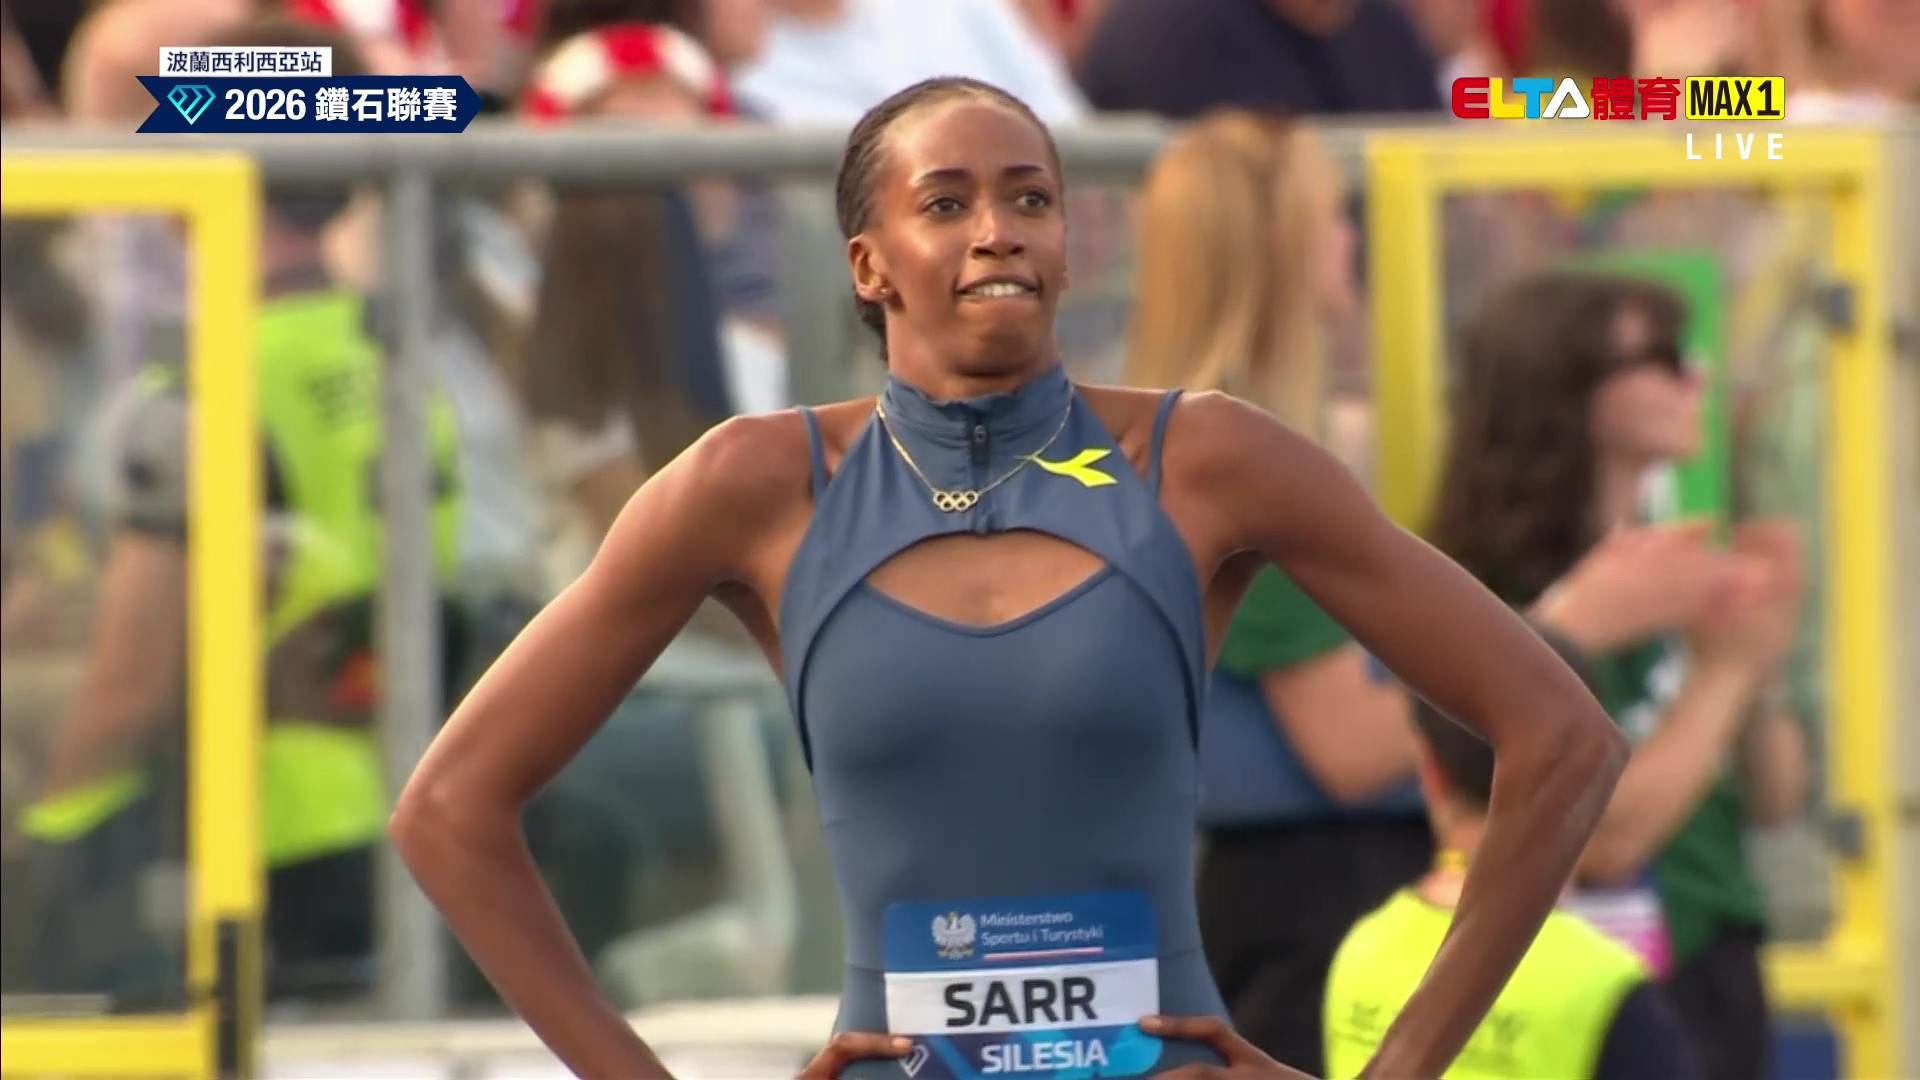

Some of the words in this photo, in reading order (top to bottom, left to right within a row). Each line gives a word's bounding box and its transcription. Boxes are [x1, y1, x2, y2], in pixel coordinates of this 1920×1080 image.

[981, 911, 1073, 926] Ministerstwo
[981, 930, 1030, 946] Sportu
[1042, 927, 1104, 943] Turystyki
[944, 977, 1097, 1027] SARR
[981, 1039, 1108, 1073] SILESIA
